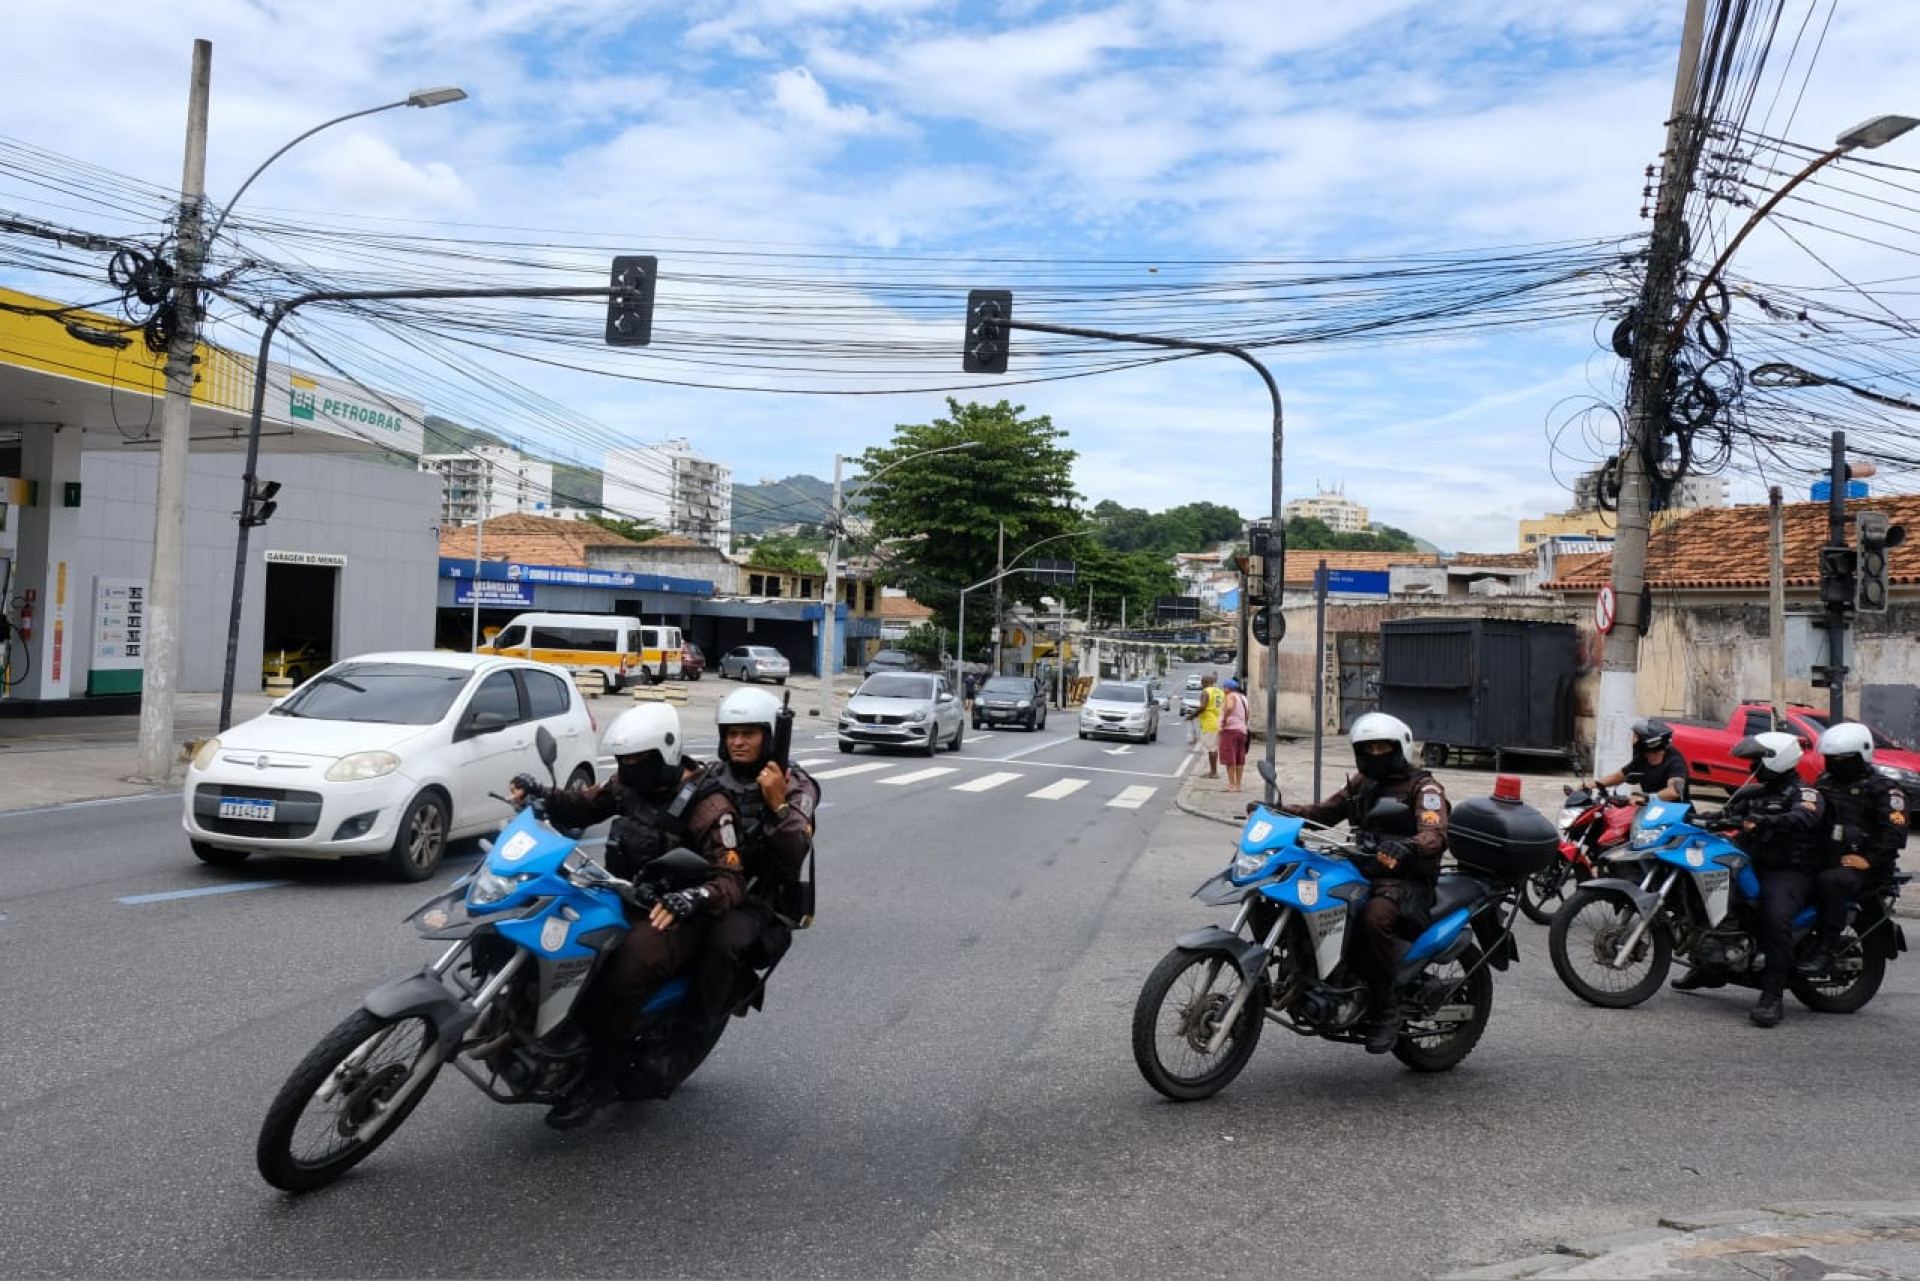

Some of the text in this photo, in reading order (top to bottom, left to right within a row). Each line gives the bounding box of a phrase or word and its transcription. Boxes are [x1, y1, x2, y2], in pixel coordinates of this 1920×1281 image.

[322, 398, 402, 432] PETROBRAS
[266, 552, 304, 563] GARAGEM
[319, 555, 345, 565] MENSAL
